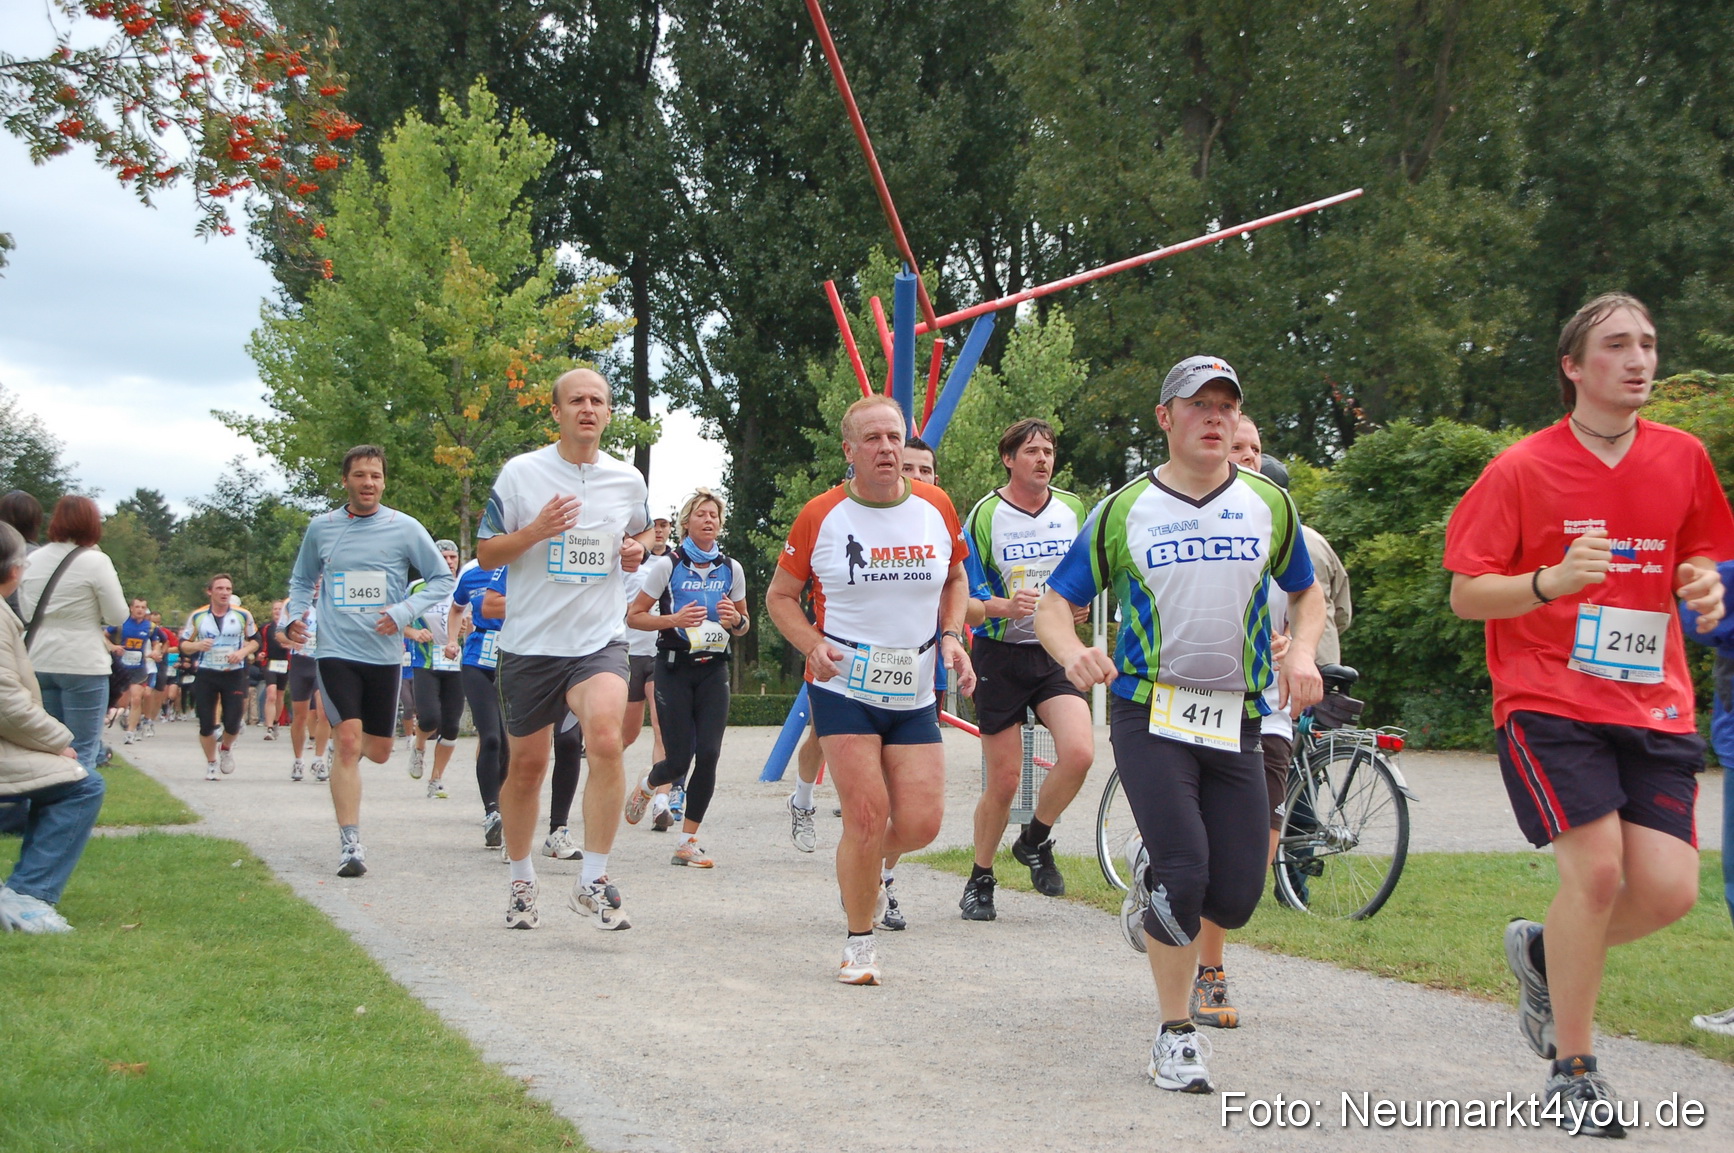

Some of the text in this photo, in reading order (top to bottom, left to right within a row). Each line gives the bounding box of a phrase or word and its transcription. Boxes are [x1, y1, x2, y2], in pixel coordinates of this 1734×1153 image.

[1148, 519, 1198, 536] TEAM
[568, 534, 600, 547] Stephan
[1632, 538, 1667, 551] 2006
[870, 544, 937, 561] MERZ
[1003, 539, 1072, 561] BOCK
[1146, 536, 1260, 569] BOCK
[568, 550, 605, 566] 3083
[868, 554, 926, 569] Reisen
[862, 572, 932, 582] TEAM 2008
[1026, 568, 1051, 578] Jürgen
[349, 587, 381, 599] 3463
[704, 632, 724, 643] 228
[1606, 630, 1657, 655] 2184
[872, 651, 913, 665] GERHARD
[870, 668, 913, 686] 2796
[1155, 693, 1161, 704] A
[1182, 703, 1224, 729] 411
